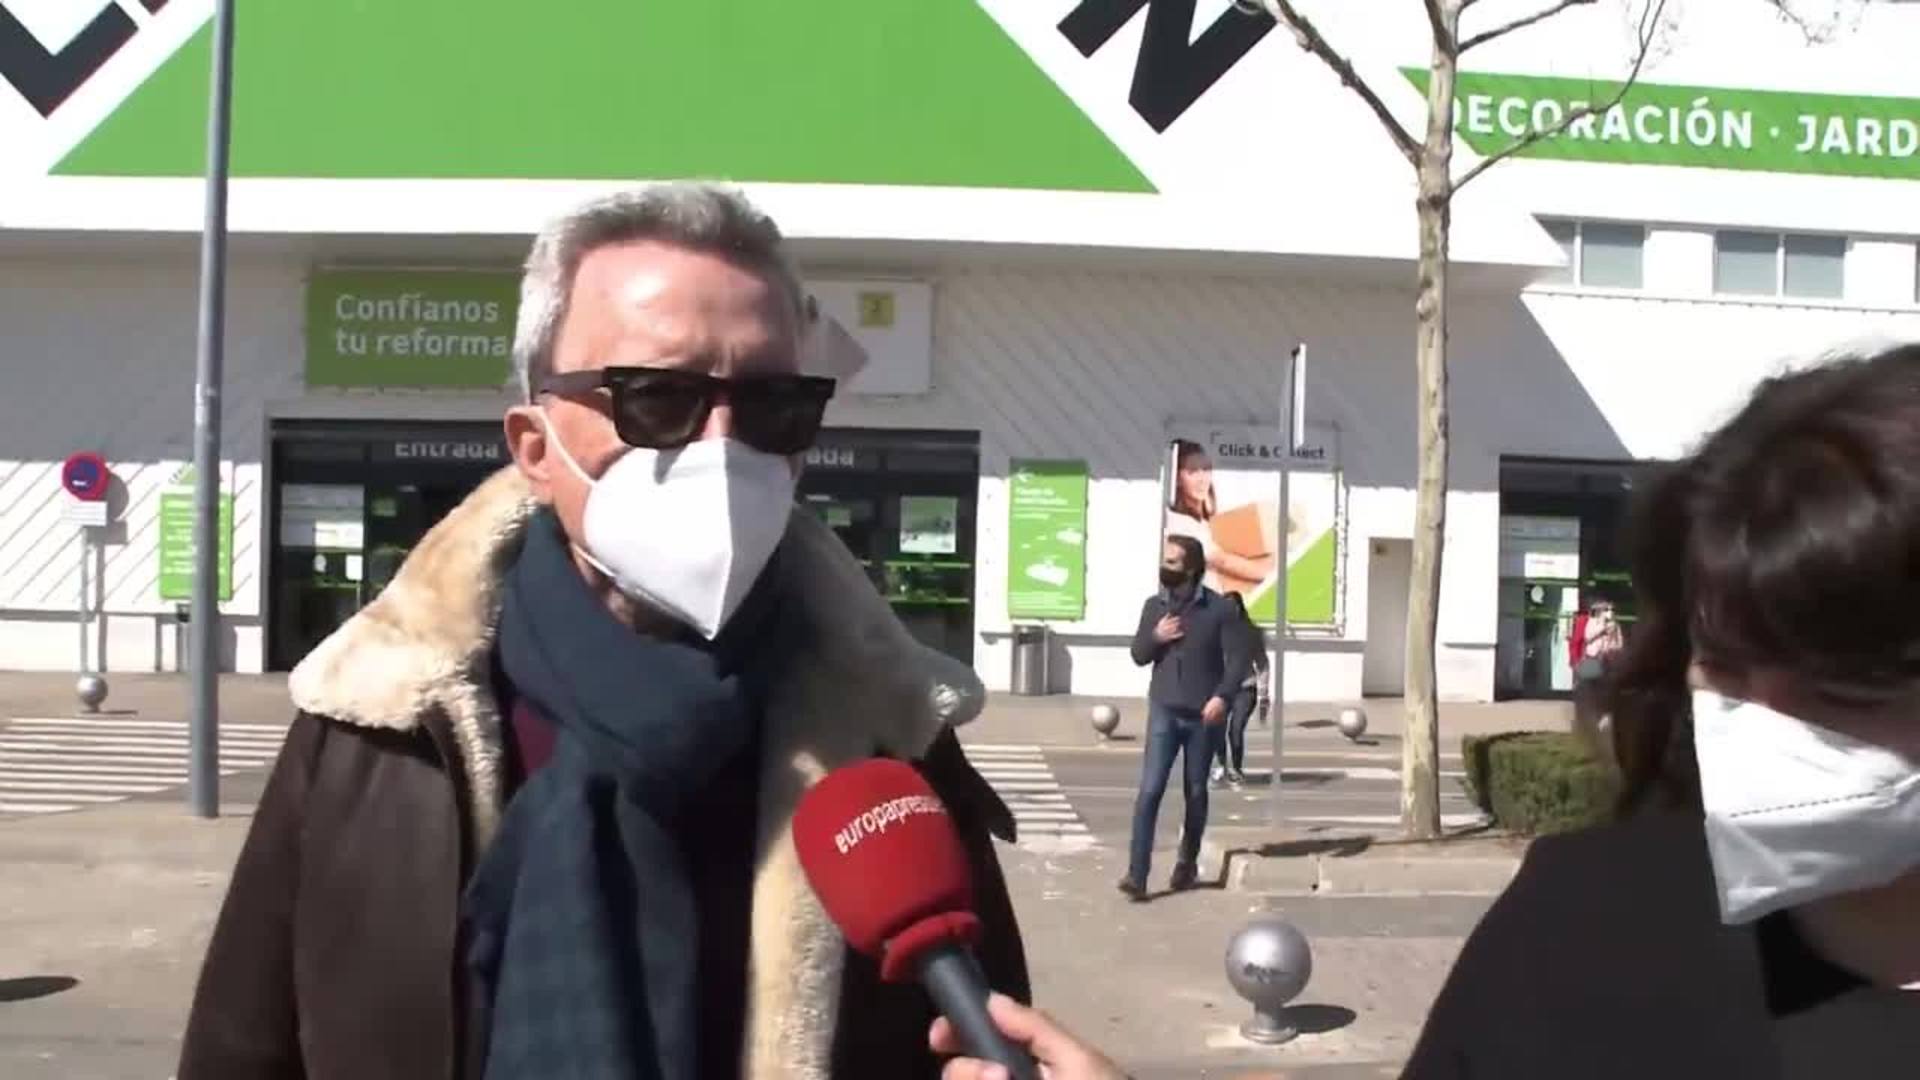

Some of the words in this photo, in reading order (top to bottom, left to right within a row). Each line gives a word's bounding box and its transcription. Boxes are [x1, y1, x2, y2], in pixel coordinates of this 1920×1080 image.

[1452, 93, 1753, 149] ECORACIÓN
[335, 293, 499, 323] Confíanos
[336, 330, 366, 355] tu
[376, 328, 508, 357] reforma
